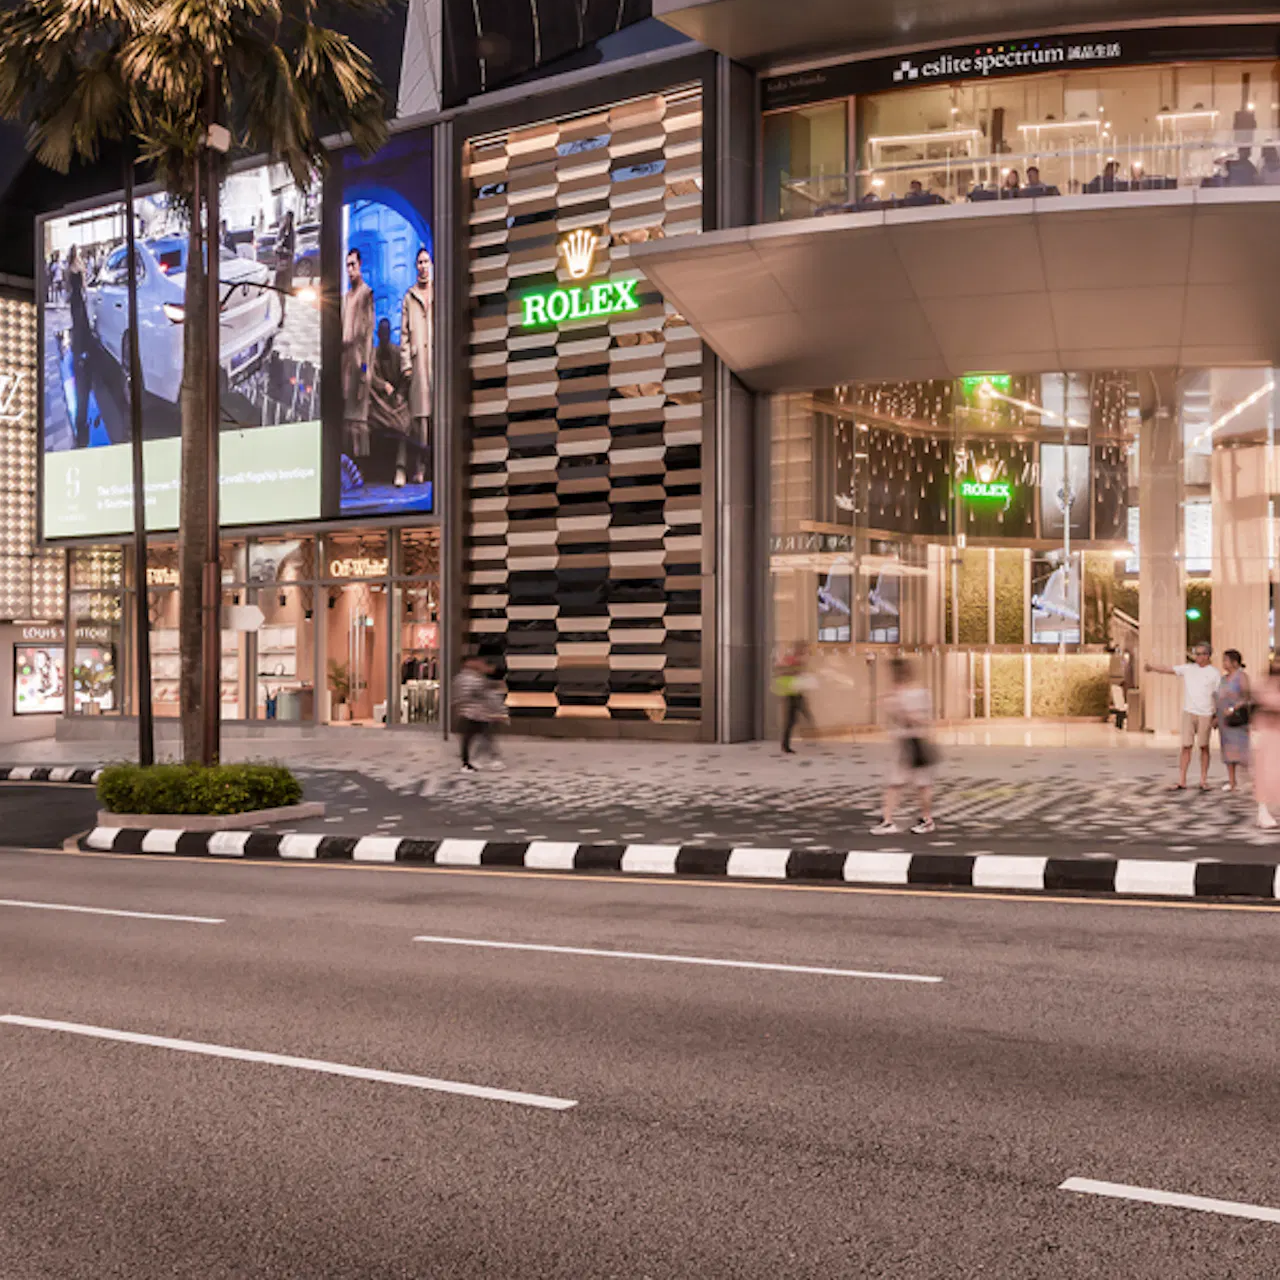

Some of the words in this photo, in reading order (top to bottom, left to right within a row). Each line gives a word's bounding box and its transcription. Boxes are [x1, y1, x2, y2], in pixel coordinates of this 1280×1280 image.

[921, 53, 971, 77] eslite
[973, 47, 1064, 76] spectrum
[522, 279, 639, 325] ROLEX
[962, 483, 1010, 497] ROLEX
[23, 627, 57, 639] LOUIS
